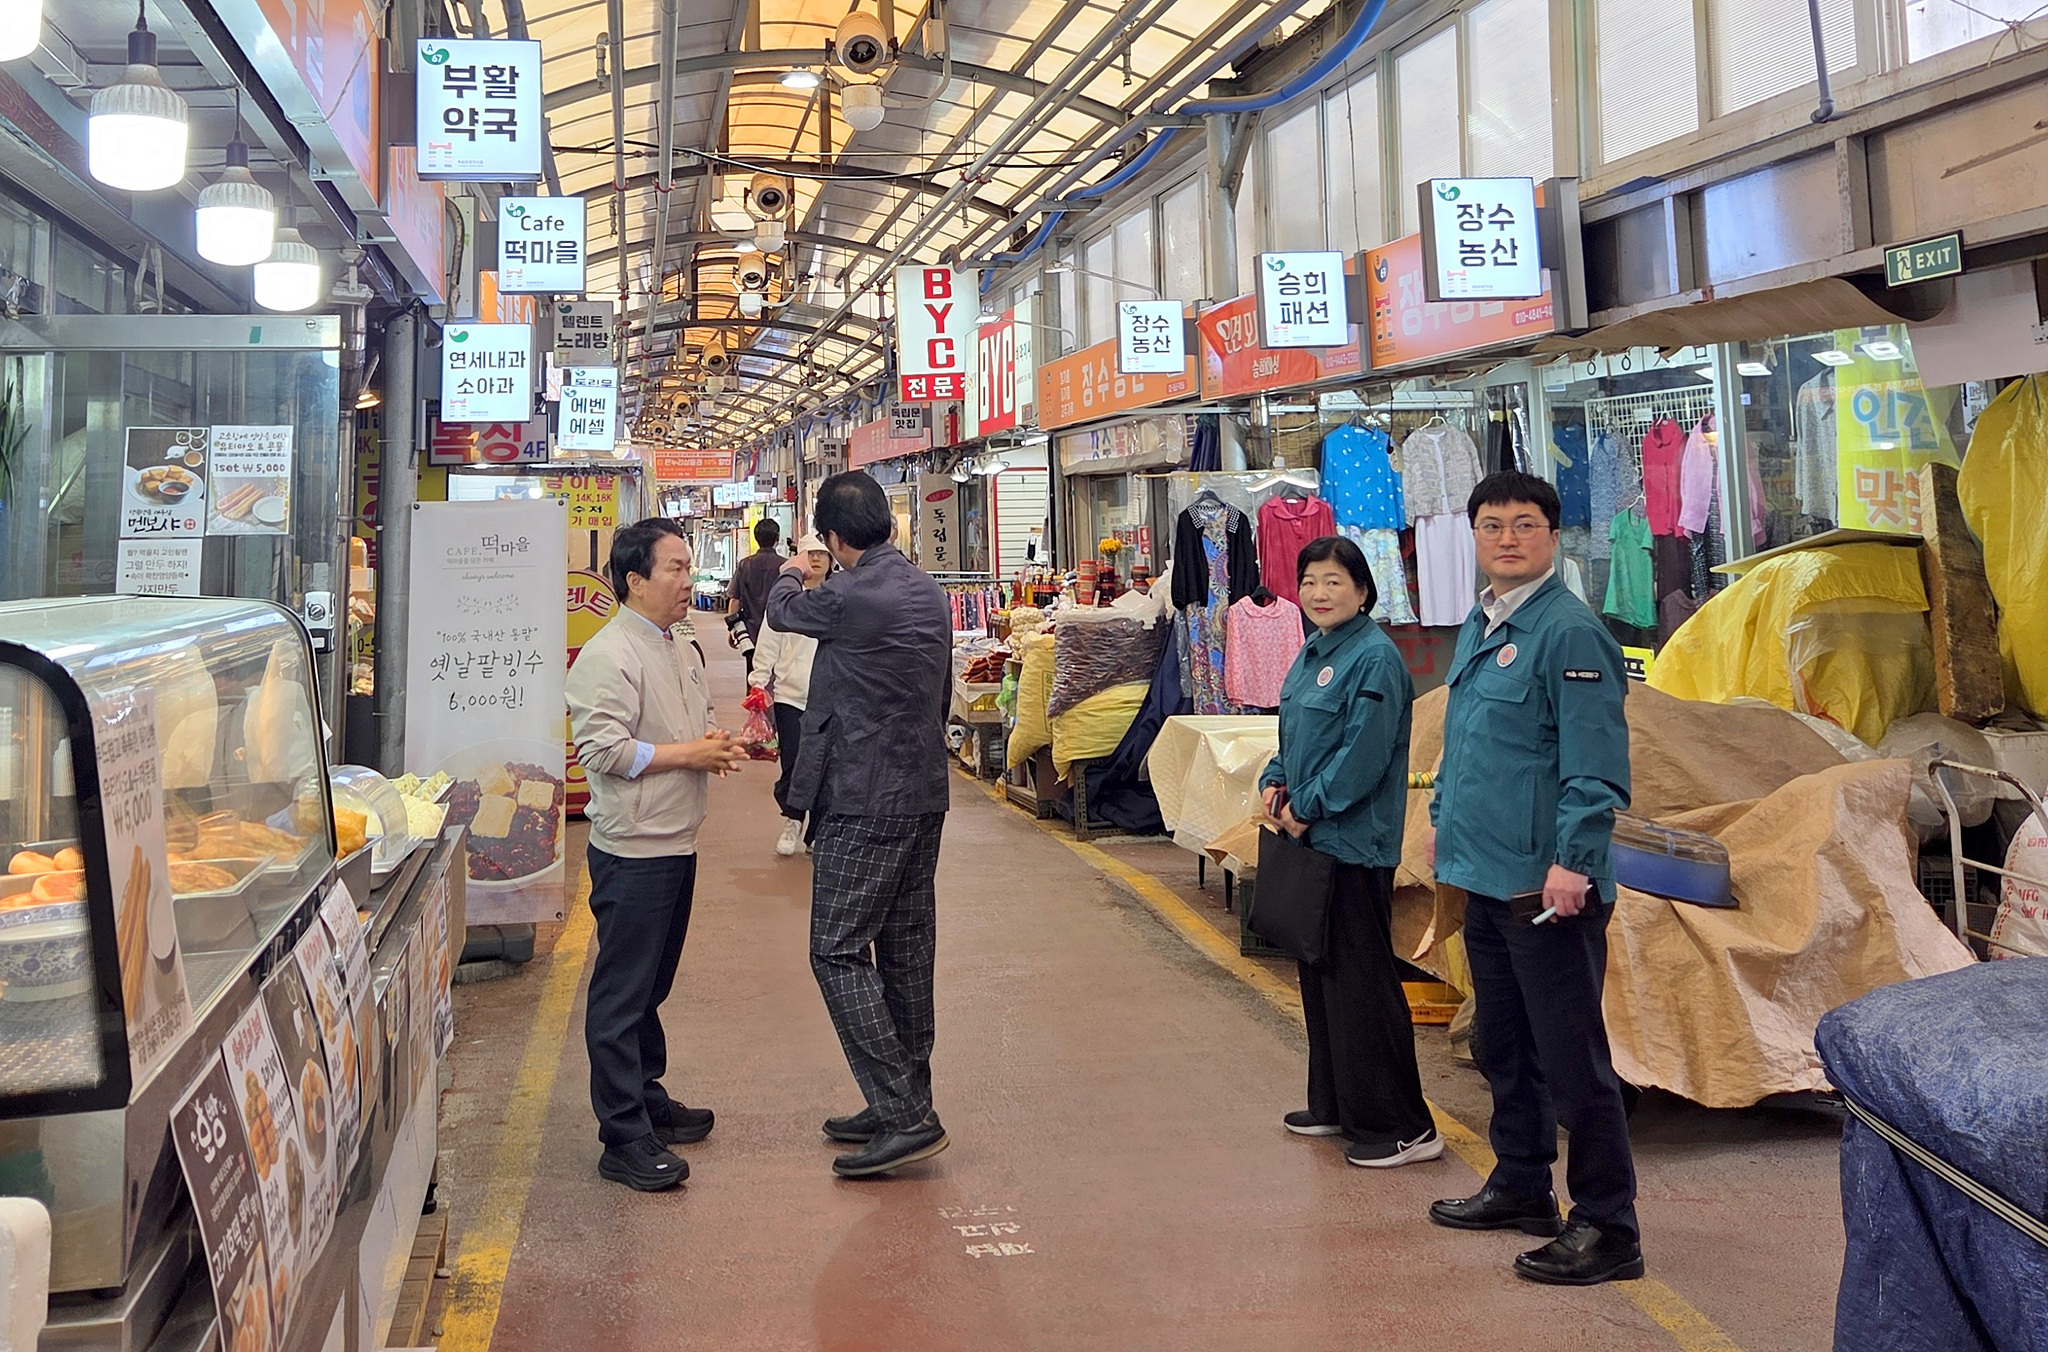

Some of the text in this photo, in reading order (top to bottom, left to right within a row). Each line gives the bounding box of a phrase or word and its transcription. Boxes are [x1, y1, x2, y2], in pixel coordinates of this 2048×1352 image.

[442, 64, 520, 99] 부활
[442, 107, 518, 142] 약국
[520, 215, 565, 231] Cafe
[1456, 202, 1515, 232] 장수
[504, 240, 578, 264] 떡마을
[1458, 237, 1519, 267] 농산
[1915, 246, 1952, 270] EXIT
[1278, 271, 1327, 296] 승희
[922, 268, 956, 369] BYC
[1131, 314, 1170, 333] 장수
[1279, 300, 1330, 325] 패션
[556, 333, 609, 349] 노래방
[1132, 335, 1171, 354] 농산
[449, 350, 526, 370] 연세내과
[1251, 354, 1280, 379] 승희패션
[979, 324, 1014, 422] BYC
[456, 377, 514, 395] 소아과
[907, 377, 966, 399] 전문
[570, 397, 606, 415] 에벤
[569, 418, 605, 435] 에셀
[895, 419, 916, 429] 맛집
[523, 441, 546, 459] 4F
[214, 463, 240, 472] 1set
[256, 463, 286, 474] 5,000
[128, 515, 182, 533] 멘보샤
[481, 533, 531, 557] 떡마을
[486, 571, 515, 579] welcome
[470, 628, 506, 643] 국내산
[429, 649, 544, 682] 옛날팥빙수
[448, 685, 525, 712] 6,000원!
